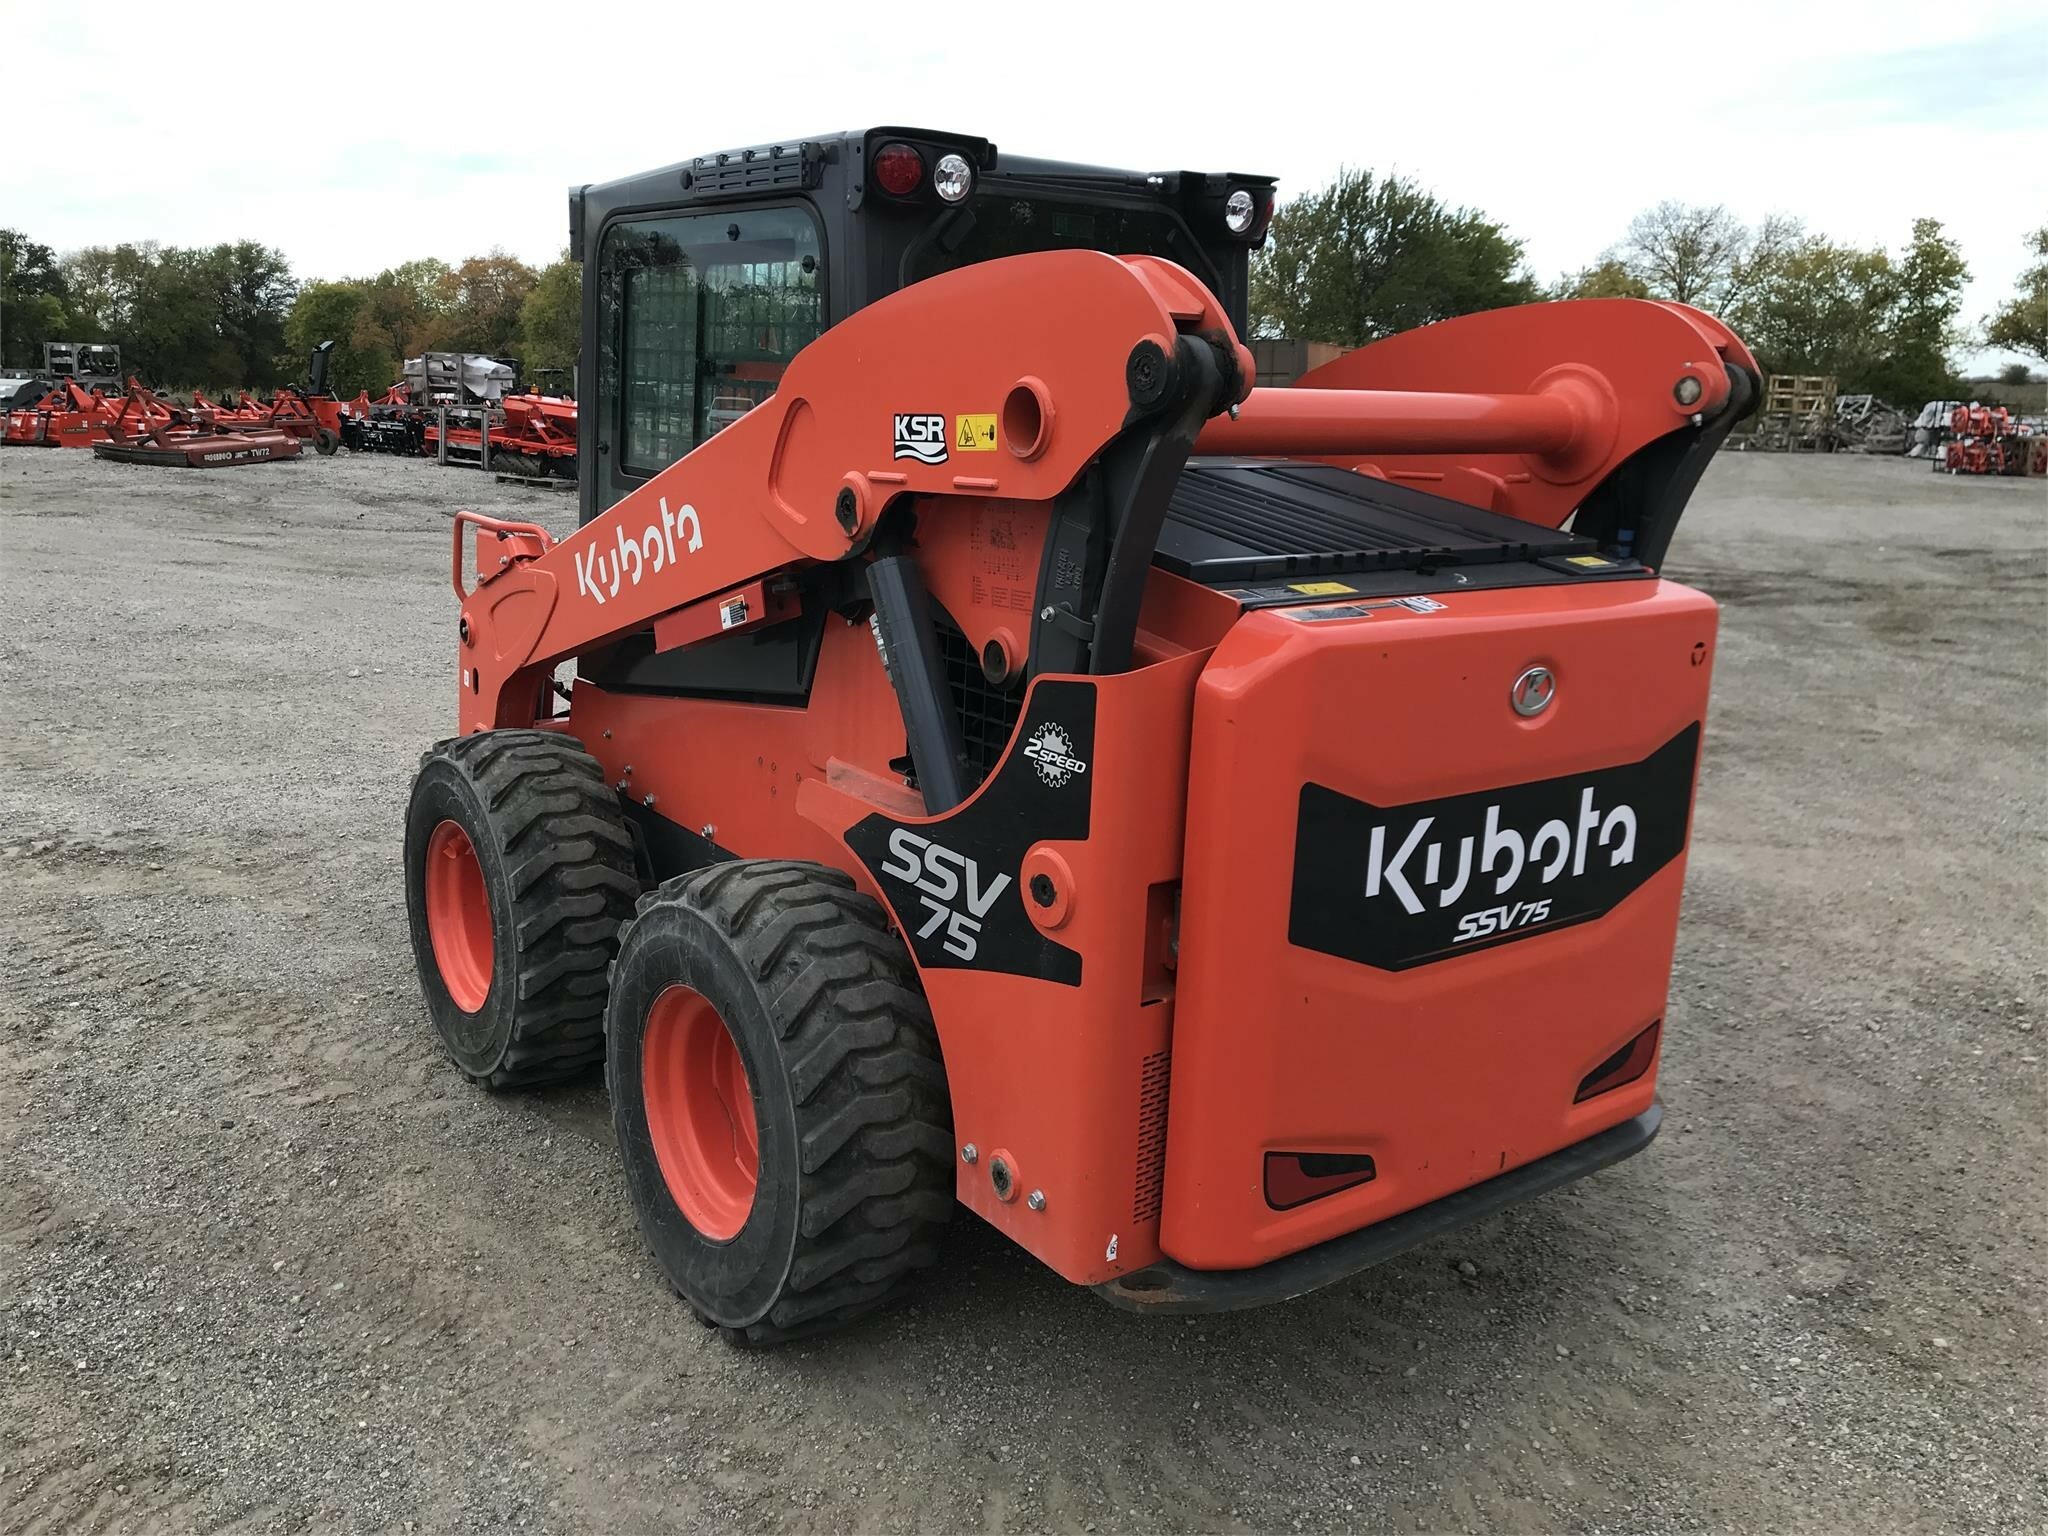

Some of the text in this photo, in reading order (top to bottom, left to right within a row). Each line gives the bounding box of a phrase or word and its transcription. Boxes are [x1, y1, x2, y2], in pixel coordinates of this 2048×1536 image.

[894, 415, 945, 441] KSR
[574, 496, 703, 604] Kubota
[881, 828, 1013, 918] SSV
[1365, 786, 1637, 915] Kubota
[916, 895, 982, 961] 75
